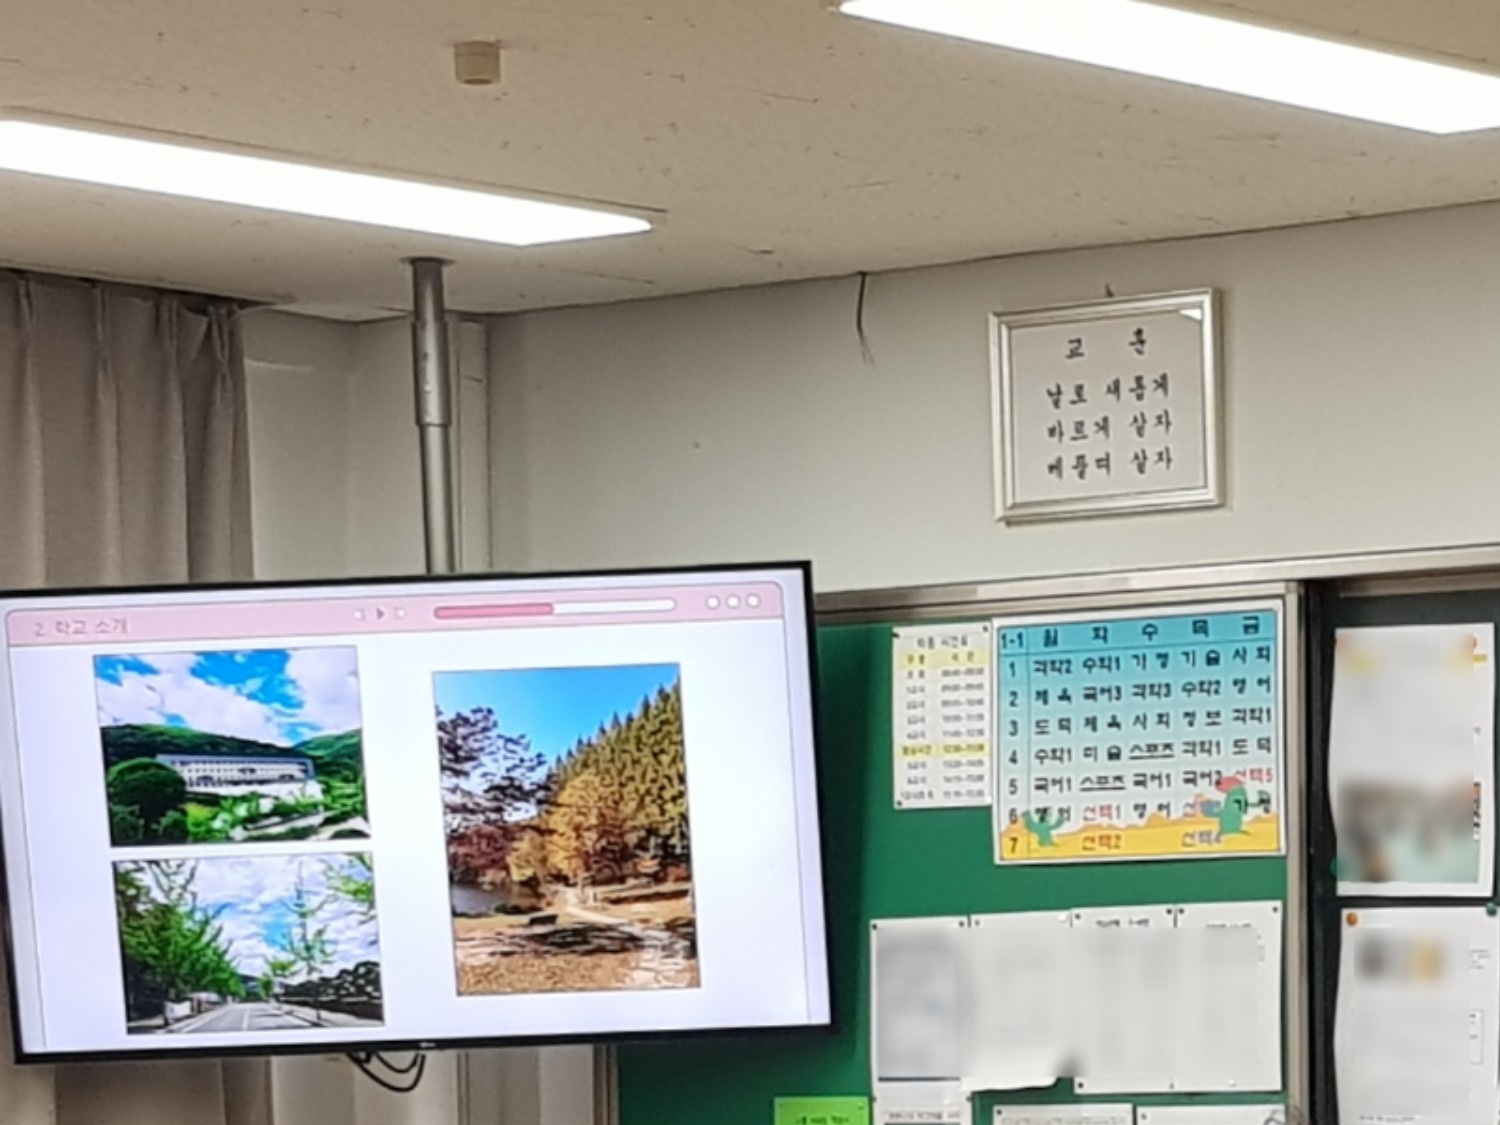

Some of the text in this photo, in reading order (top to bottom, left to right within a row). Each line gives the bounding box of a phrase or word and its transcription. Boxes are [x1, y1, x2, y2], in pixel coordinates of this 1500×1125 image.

[1065, 327, 1148, 360] 교 훈
[1046, 371, 1169, 410] 날로 새롭게
[1047, 408, 1172, 444] 바르게 살자
[1130, 445, 1173, 475] 살자
[95, 618, 128, 635] 소개
[1001, 631, 1024, 650] 1-1
[1141, 623, 1159, 641] 수
[1192, 619, 1209, 638] 목
[1242, 615, 1259, 635] 금
[1082, 655, 1120, 674] 수학1
[1009, 690, 1018, 707] 2
[1009, 719, 1018, 737] 3
[1008, 748, 1018, 765] 4
[1034, 747, 1072, 766] 수학1
[1008, 777, 1018, 795] 5
[1008, 807, 1018, 824] 6
[1009, 836, 1018, 854] 7
